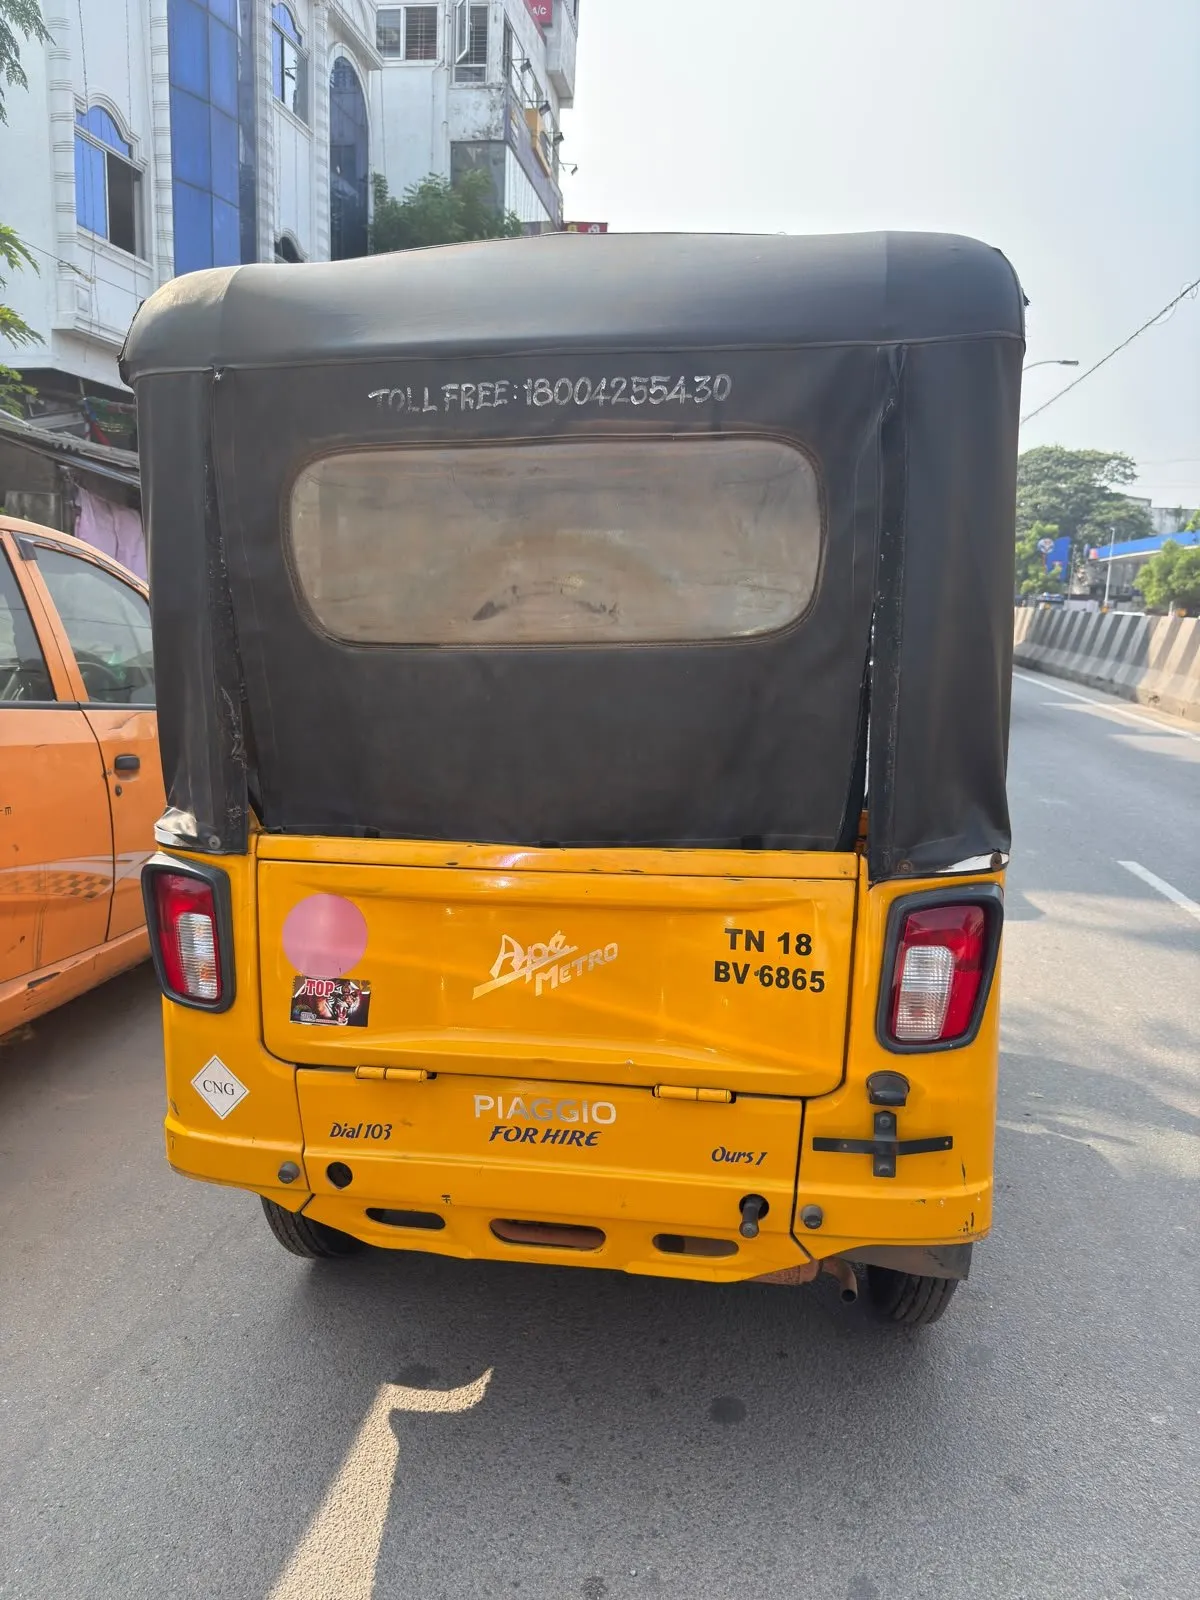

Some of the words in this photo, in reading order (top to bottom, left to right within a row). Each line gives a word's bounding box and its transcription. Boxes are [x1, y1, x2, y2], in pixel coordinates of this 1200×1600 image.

[368, 387, 438, 413] TOLL
[724, 927, 765, 953] TN
[777, 932, 812, 956] 18
[714, 960, 750, 985] BV
[759, 965, 825, 993] 6865
[202, 1079, 235, 1096] CNG
[473, 1094, 618, 1125] PIAGGIO
[329, 1122, 363, 1139] Dial
[363, 1123, 393, 1140] 103
[489, 1125, 538, 1145] FOR
[540, 1127, 603, 1148] HIRE
[711, 1146, 753, 1165] Ours
